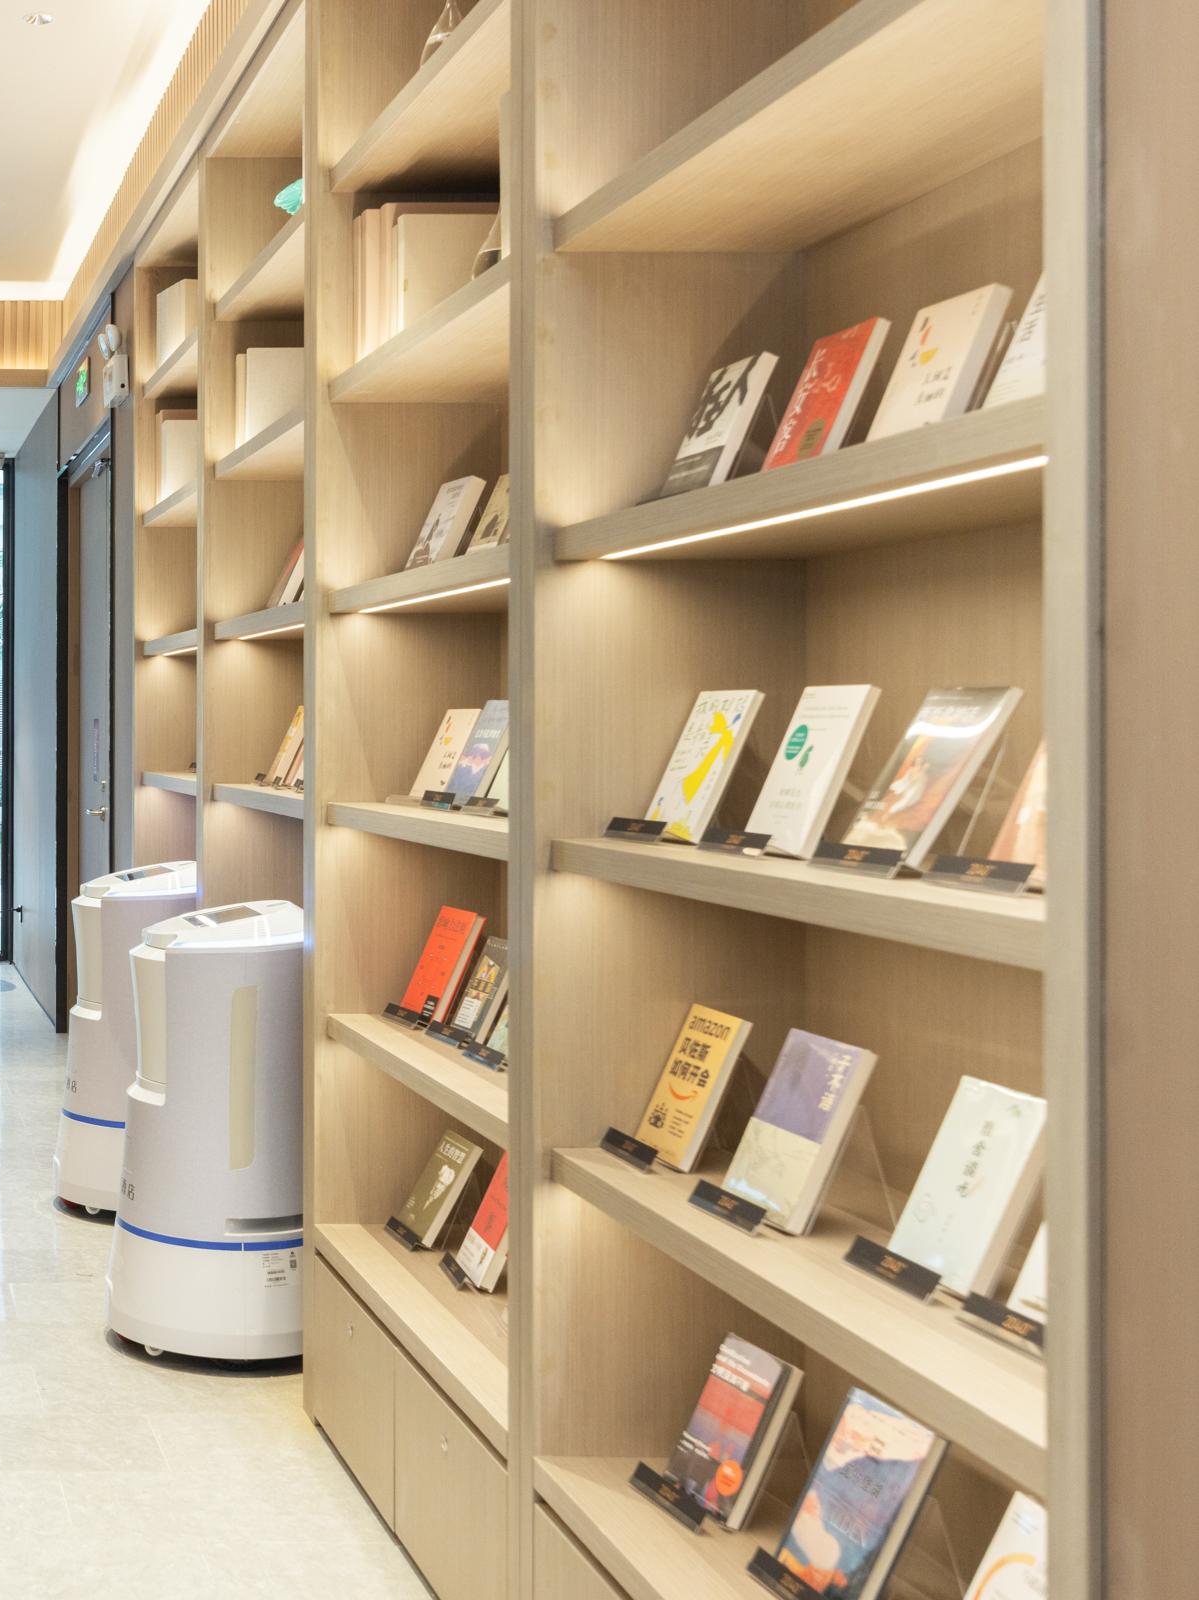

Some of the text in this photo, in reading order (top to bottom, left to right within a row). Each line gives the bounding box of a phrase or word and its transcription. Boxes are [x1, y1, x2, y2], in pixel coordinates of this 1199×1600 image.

[689, 1016, 730, 1040] amazon
[669, 1059, 710, 1087] 如何开会
